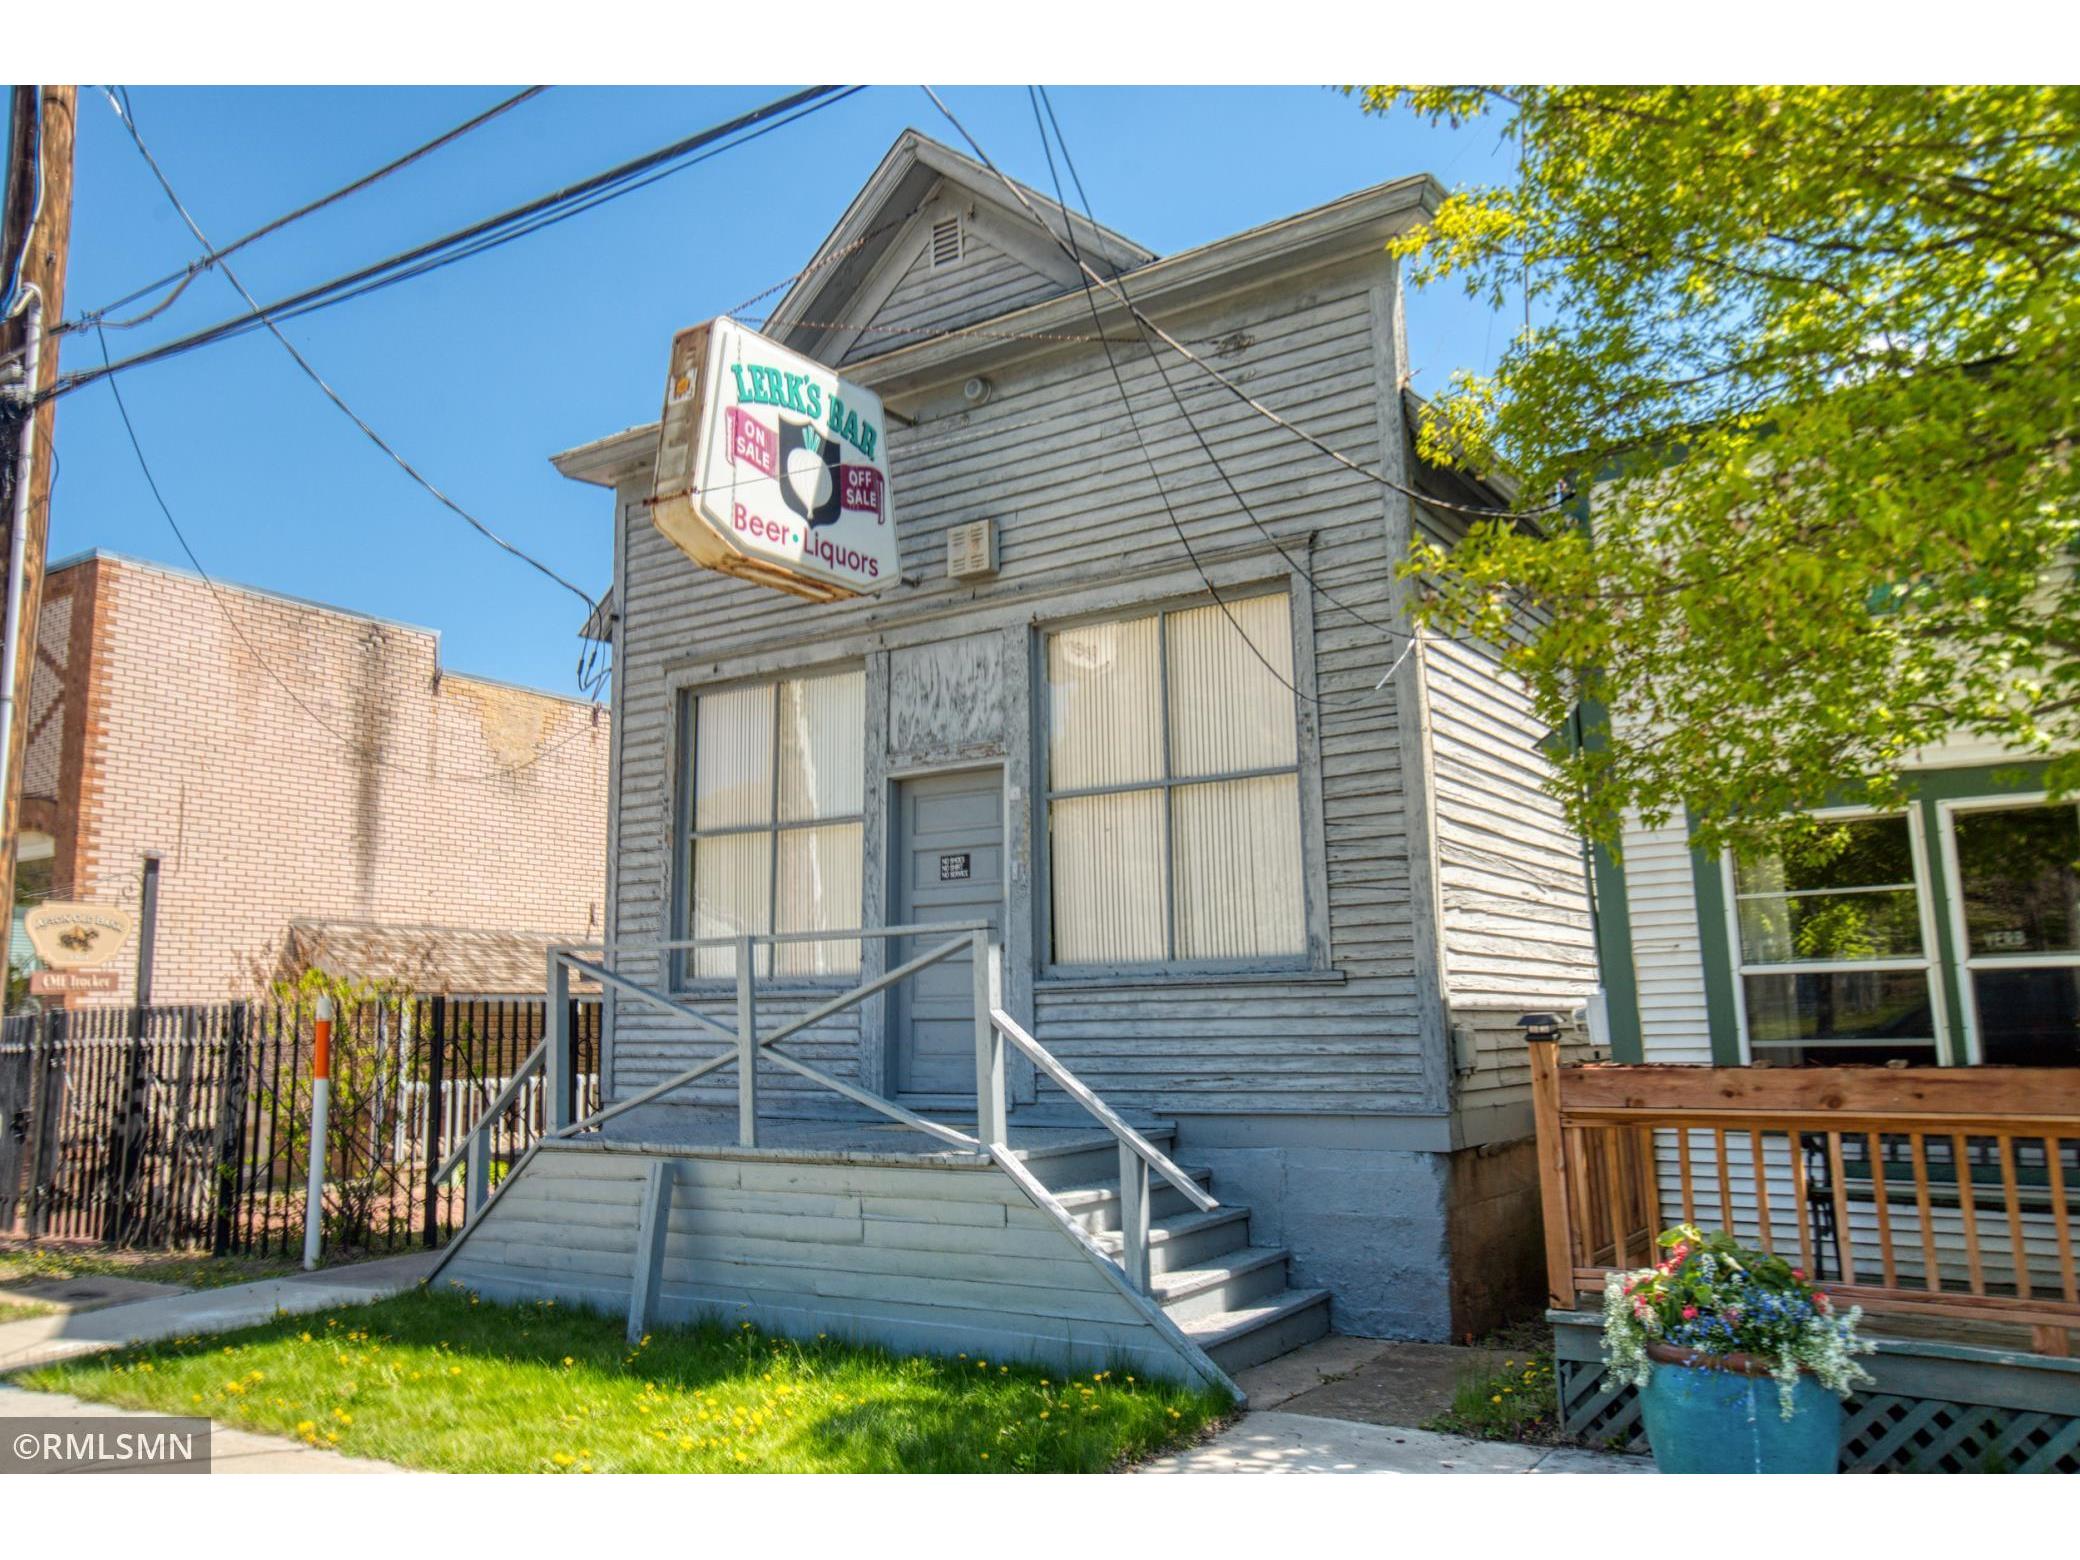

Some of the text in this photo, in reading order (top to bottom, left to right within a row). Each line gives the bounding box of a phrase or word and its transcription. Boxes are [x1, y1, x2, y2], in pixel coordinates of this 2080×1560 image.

[731, 363, 878, 460] LERK'S BAR
[744, 420, 765, 442] ON
[736, 438, 770, 469] SALE
[849, 470, 872, 489] OFF
[846, 487, 877, 508] SALE
[733, 502, 879, 577] Beer Liquors
